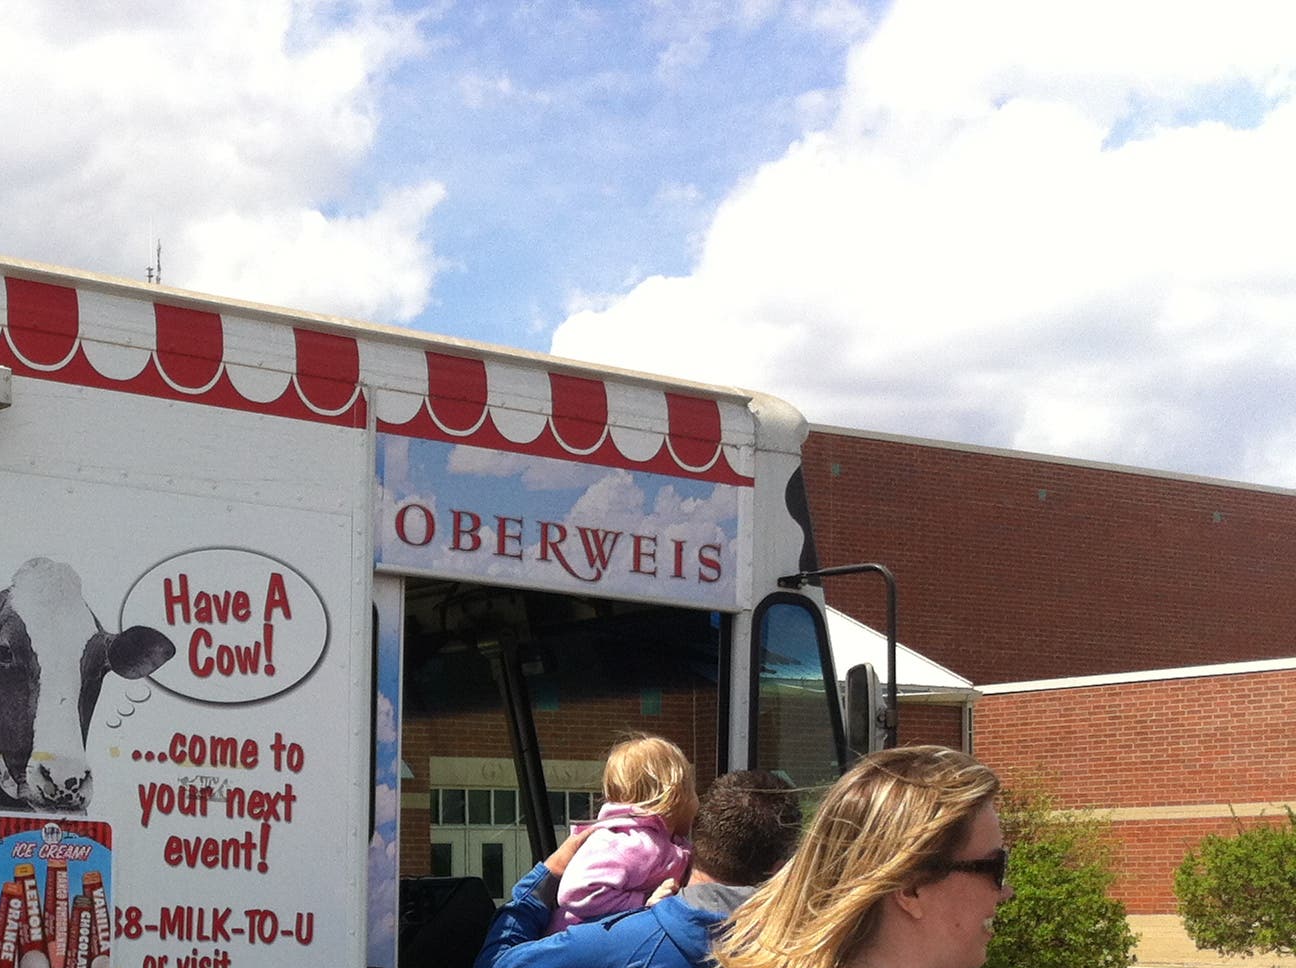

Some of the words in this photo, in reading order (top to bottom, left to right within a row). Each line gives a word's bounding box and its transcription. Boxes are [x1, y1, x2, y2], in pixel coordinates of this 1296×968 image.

[395, 504, 722, 583] OBERWEIS
[164, 573, 252, 626] Have
[263, 572, 292, 622] A
[188, 623, 276, 678] Cow!
[270, 732, 305, 773] to
[138, 782, 210, 828] your
[226, 783, 297, 823] next
[38, 843, 92, 861] CREAM!
[163, 821, 271, 875] event!
[1, 898, 22, 961] ORANGE
[24, 879, 43, 941] LEMON
[92, 887, 110, 952] VANILLA
